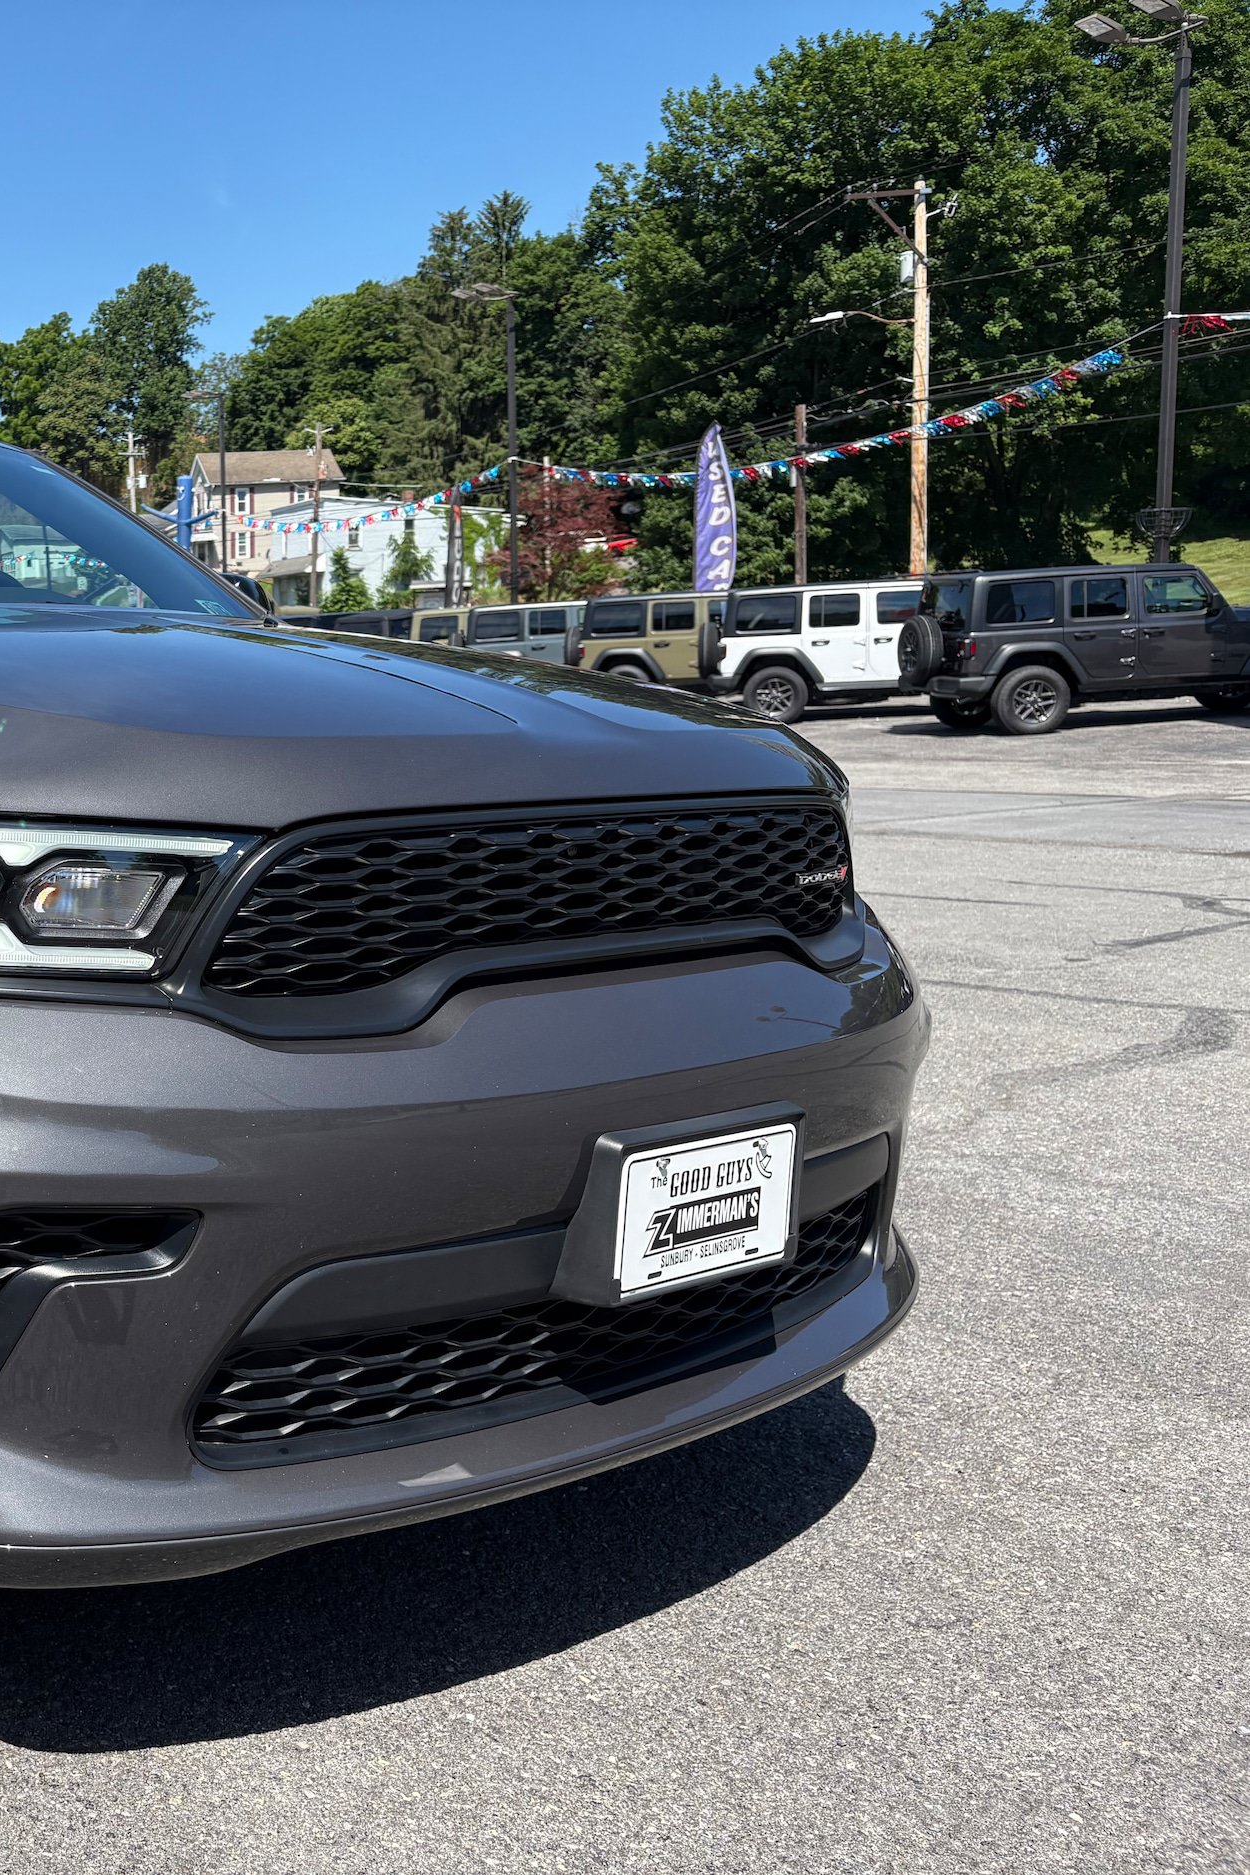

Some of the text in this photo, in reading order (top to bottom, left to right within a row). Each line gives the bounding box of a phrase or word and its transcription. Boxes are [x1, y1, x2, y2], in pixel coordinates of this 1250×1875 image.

[799, 868, 842, 885] DODGE
[651, 1157, 753, 1197] The GOOD GUYS
[642, 1191, 760, 1259] ZIMMERMAN'S
[660, 1249, 693, 1268] SUNBURY
[700, 1236, 746, 1259] SELINSGROVE
